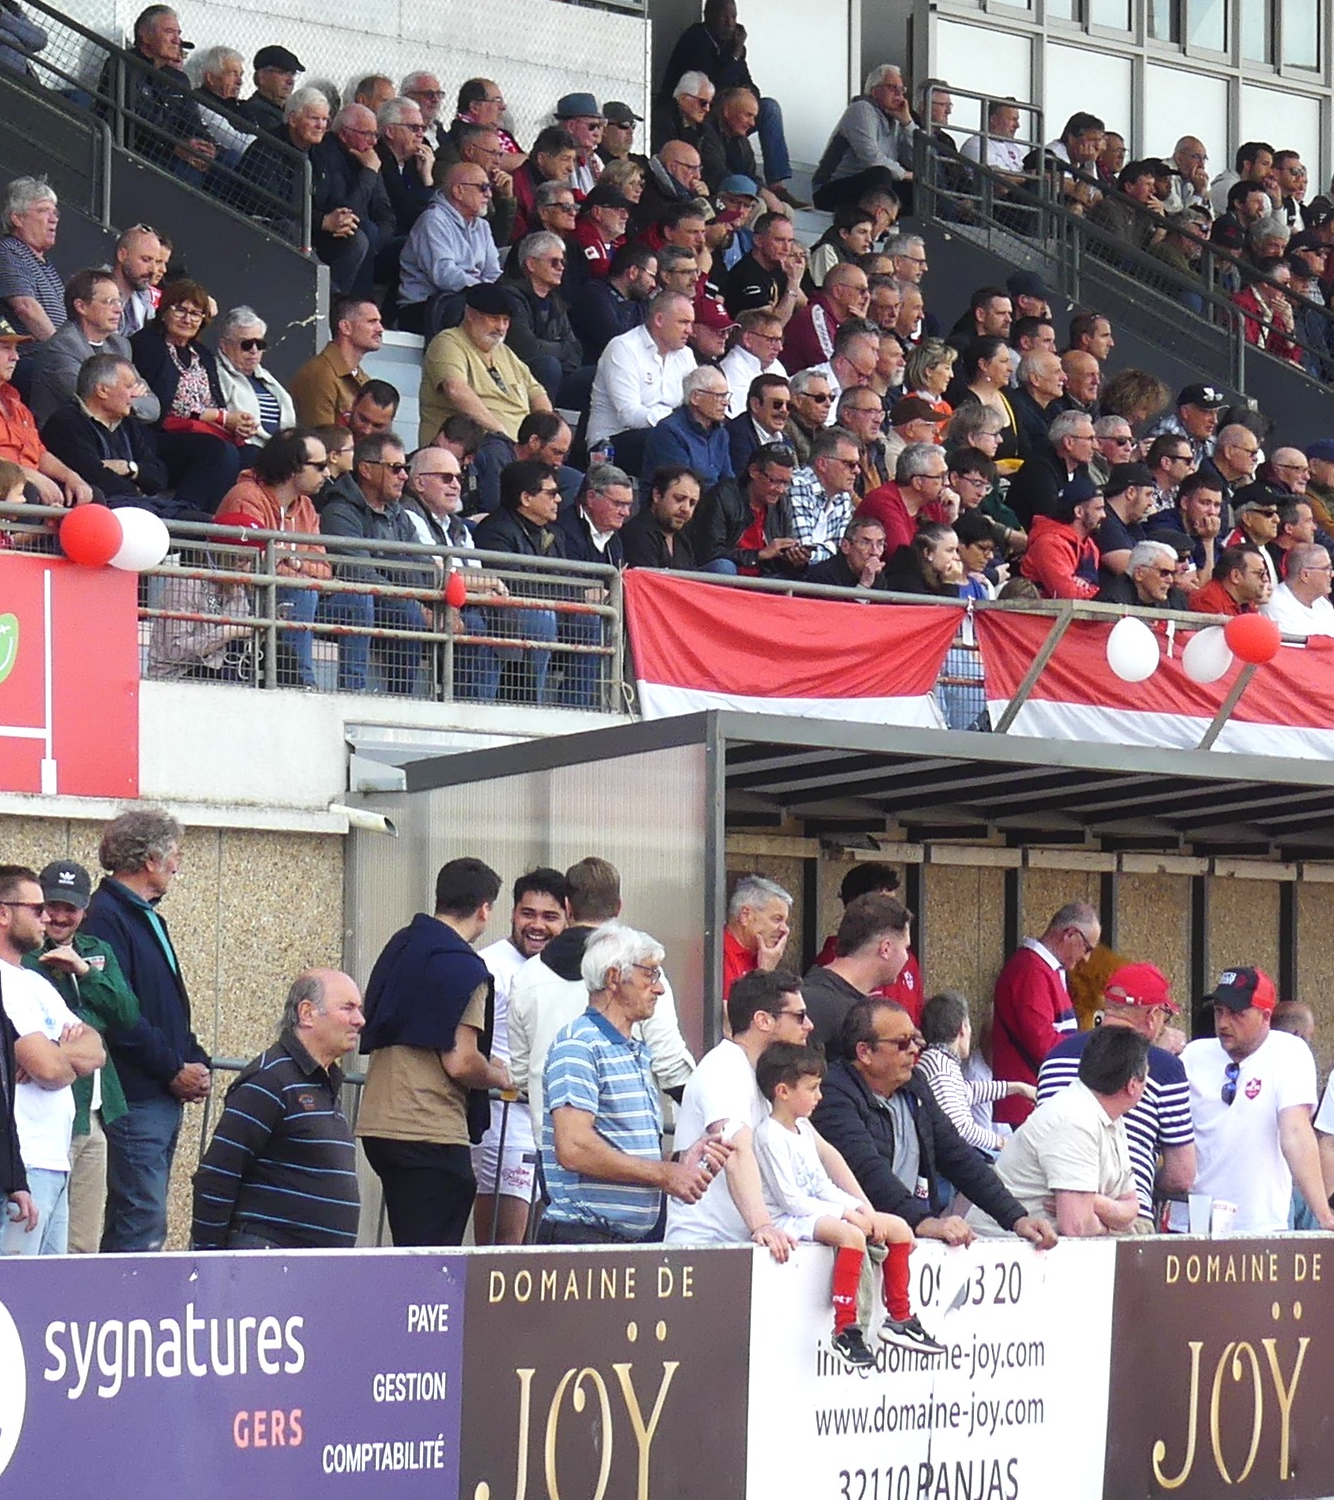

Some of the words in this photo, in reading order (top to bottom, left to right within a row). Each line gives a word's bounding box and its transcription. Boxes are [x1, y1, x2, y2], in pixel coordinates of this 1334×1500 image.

[488, 1266, 637, 1304] DOMAINE
[657, 1266, 694, 1298] DE
[920, 1262, 940, 1307] 0
[993, 1261, 1022, 1305] 20
[1166, 1253, 1279, 1285] DOMAINE
[1294, 1252, 1322, 1282] DE
[407, 1303, 449, 1334] PAYE
[43, 1302, 307, 1400] sygnatures
[816, 1333, 1045, 1380] indomaine-joy.com
[373, 1372, 446, 1403] GESTION
[1152, 1301, 1310, 1489] JOŸ
[232, 1408, 303, 1449] GERS
[475, 1319, 680, 1500] JOŸ
[815, 1391, 1045, 1438] www.domaine-joy.com
[322, 1434, 445, 1474] COMPTABILITÉ
[838, 1464, 911, 1500] 32110
[915, 1457, 1019, 1500] PANJAS
